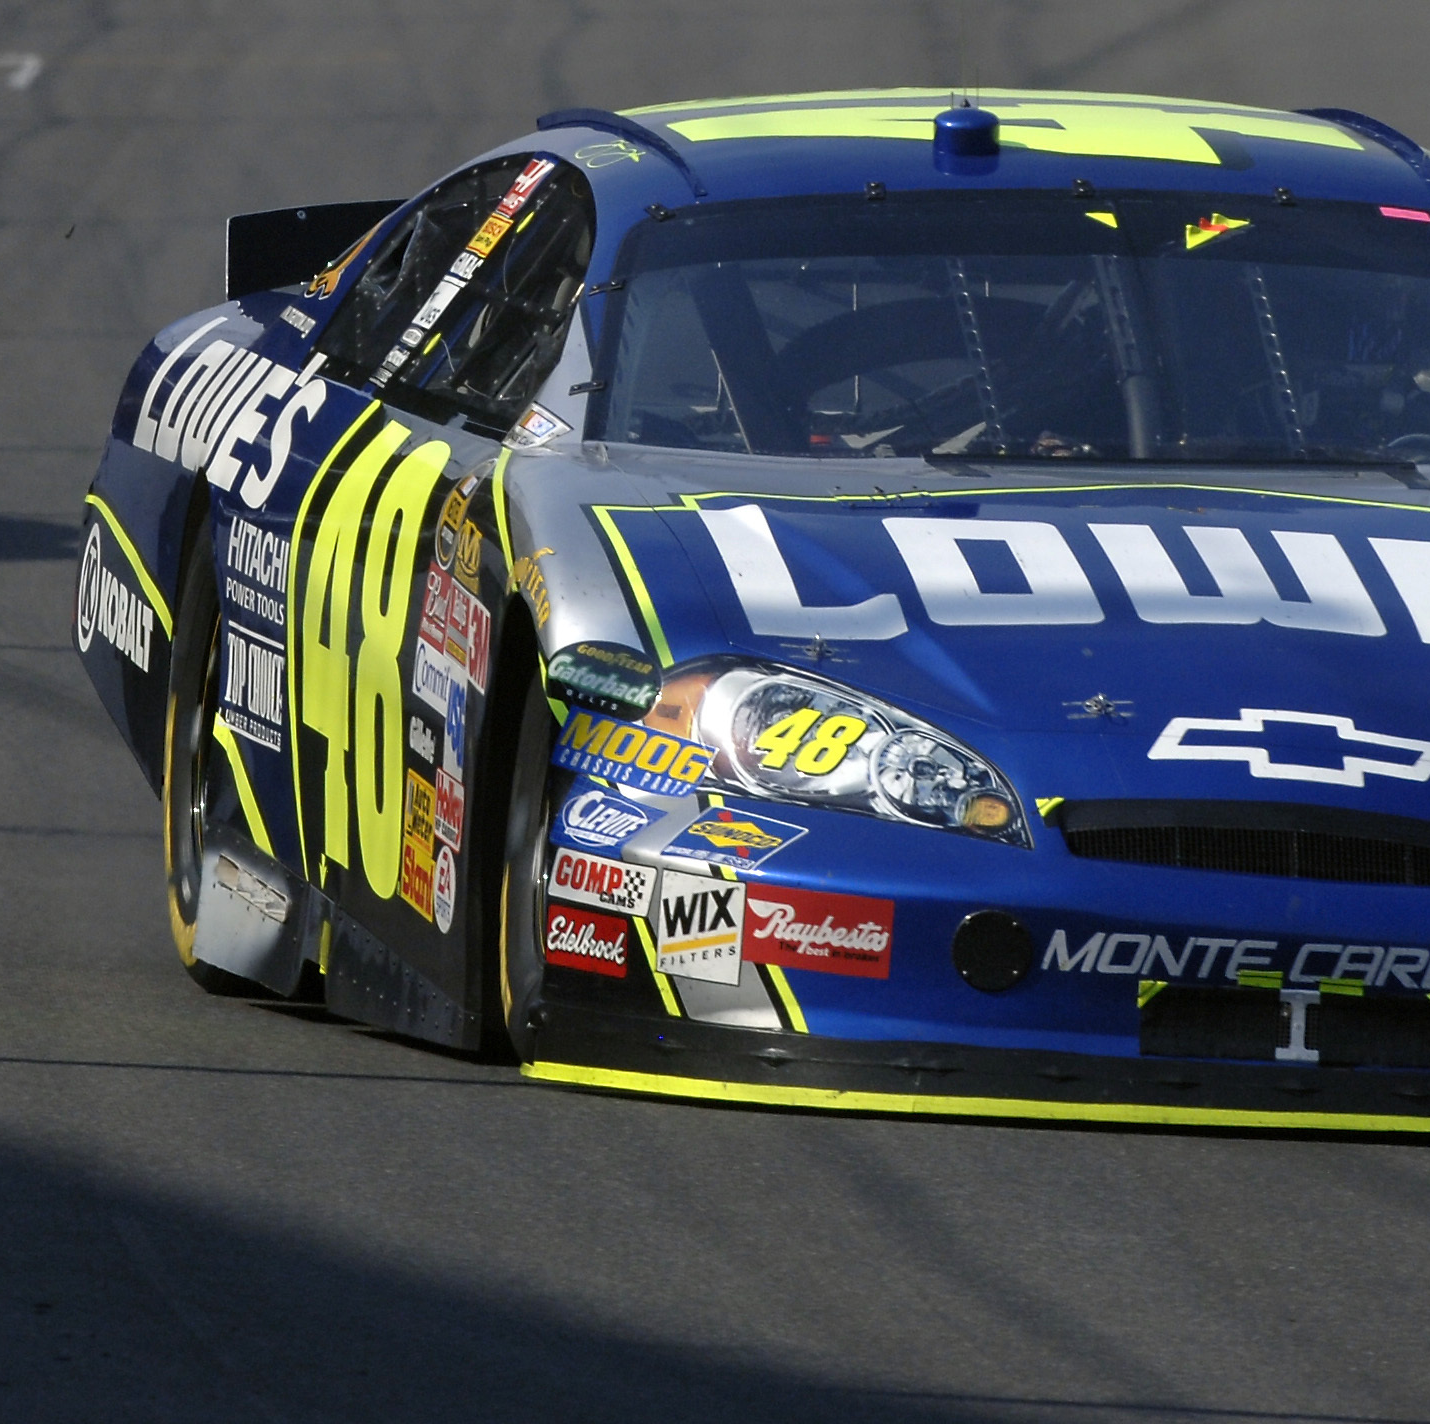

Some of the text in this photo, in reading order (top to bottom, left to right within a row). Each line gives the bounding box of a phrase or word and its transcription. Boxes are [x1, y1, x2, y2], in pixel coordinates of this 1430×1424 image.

[132, 315, 329, 510] LOWE'S
[227, 515, 290, 594] HITACHI
[97, 566, 154, 674] KOBALT
[226, 576, 285, 626] POWER TOOLS
[224, 631, 285, 726] TOP CHOICE
[302, 418, 452, 900] 48
[415, 642, 451, 704] Commit
[547, 654, 654, 708] Gatorback
[576, 643, 654, 675] GOODYEAR
[565, 689, 618, 711] BELTS
[559, 712, 714, 784] MOOG
[753, 706, 869, 777] 48
[558, 748, 693, 796] CHASSIS PARTS
[568, 789, 649, 839] CLEVITE
[690, 822, 783, 848] SUNOCO
[555, 854, 623, 896] COMP
[599, 892, 636, 910] CAMS
[662, 887, 740, 938] WIX
[747, 898, 890, 954] Raybestos
[546, 915, 626, 965] Edelbrock
[659, 945, 737, 968] FILTERS
[1041, 929, 1277, 979] MONTE
